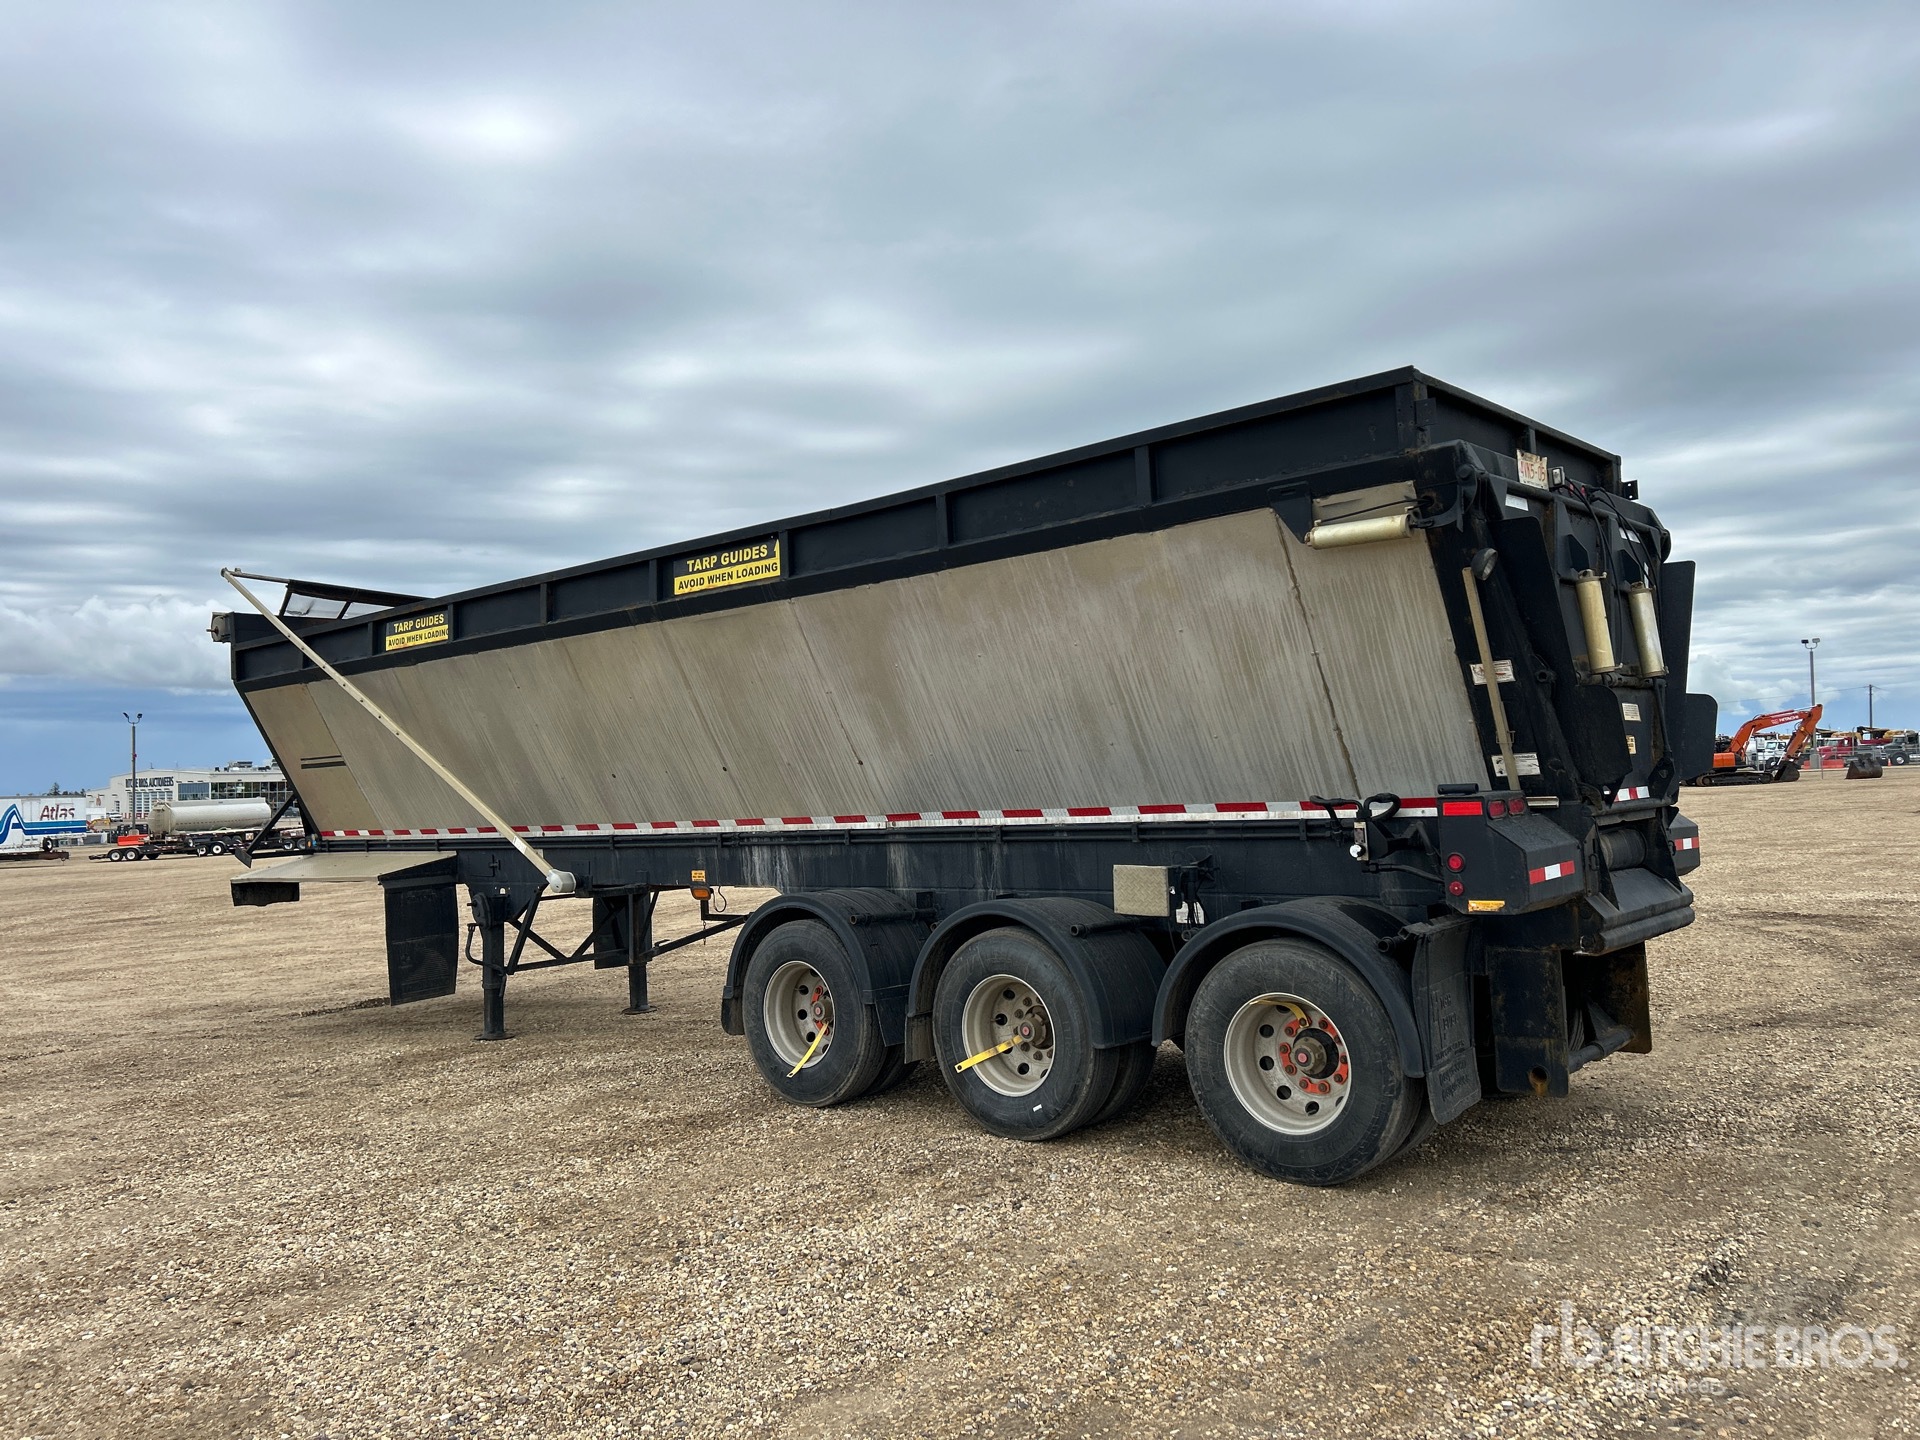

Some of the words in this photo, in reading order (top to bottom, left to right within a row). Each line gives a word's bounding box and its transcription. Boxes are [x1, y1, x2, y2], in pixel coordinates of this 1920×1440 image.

[686, 555, 717, 572] TARP
[721, 544, 768, 565] GUIDES
[678, 577, 705, 590] AVOID
[707, 571, 733, 584] WHEN
[736, 562, 778, 578] LOADING
[393, 620, 414, 633] TARP
[415, 614, 444, 628] GUIDES
[388, 637, 406, 647] AVOID
[407, 633, 423, 643] WHEN
[40, 804, 75, 820] Atlas
